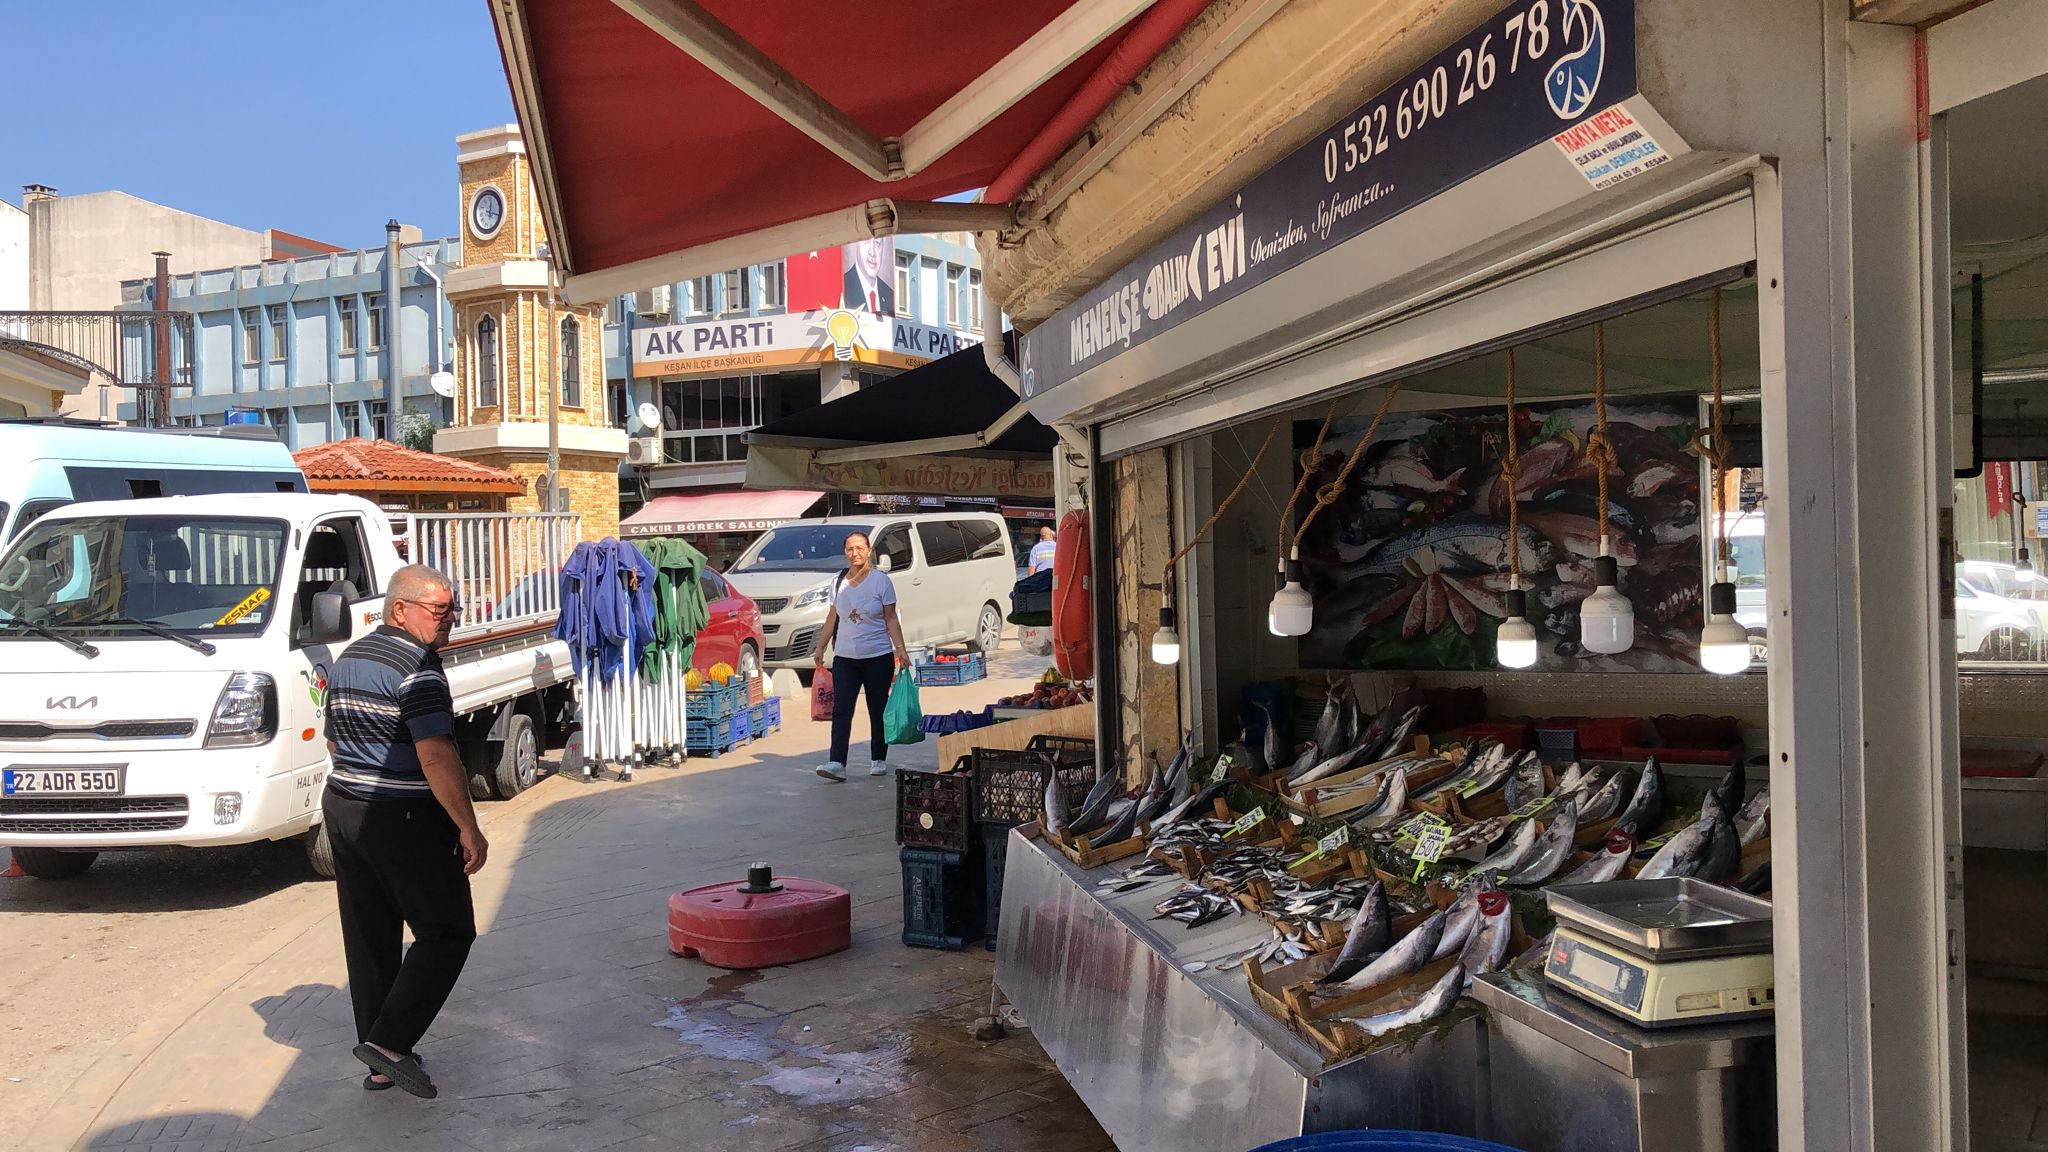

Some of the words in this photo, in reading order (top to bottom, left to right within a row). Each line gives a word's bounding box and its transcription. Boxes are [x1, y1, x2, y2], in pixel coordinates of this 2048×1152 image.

[1324, 138, 1338, 183] 0
[1344, 104, 1389, 172] 532
[1396, 66, 1448, 139] 690
[1456, 33, 1496, 105] 26
[1505, 0, 1550, 73] 78
[1554, 123, 1600, 153] TRAKYA
[1591, 107, 1633, 137] METAL
[1250, 219, 1307, 268] Denizden,
[1070, 279, 1142, 366] MENEKŞE
[1147, 255, 1190, 319] BALIK
[1206, 193, 1246, 293] EVİ
[645, 330, 684, 356] AK
[893, 324, 922, 351] AK
[928, 330, 979, 355] PART
[664, 360, 693, 373] KEŞAN
[693, 356, 712, 369] İLÇE
[714, 353, 764, 369] BAŞKANLIĞI
[677, 519, 725, 531] BÖREK
[225, 591, 265, 625] ESNAF
[46, 696, 98, 709] KIA
[14, 773, 36, 790] 22
[42, 773, 76, 790] ADR
[81, 772, 116, 790] 550
[297, 774, 311, 789] HAL
[313, 772, 323, 787] NO
[304, 792, 310, 807] 6
